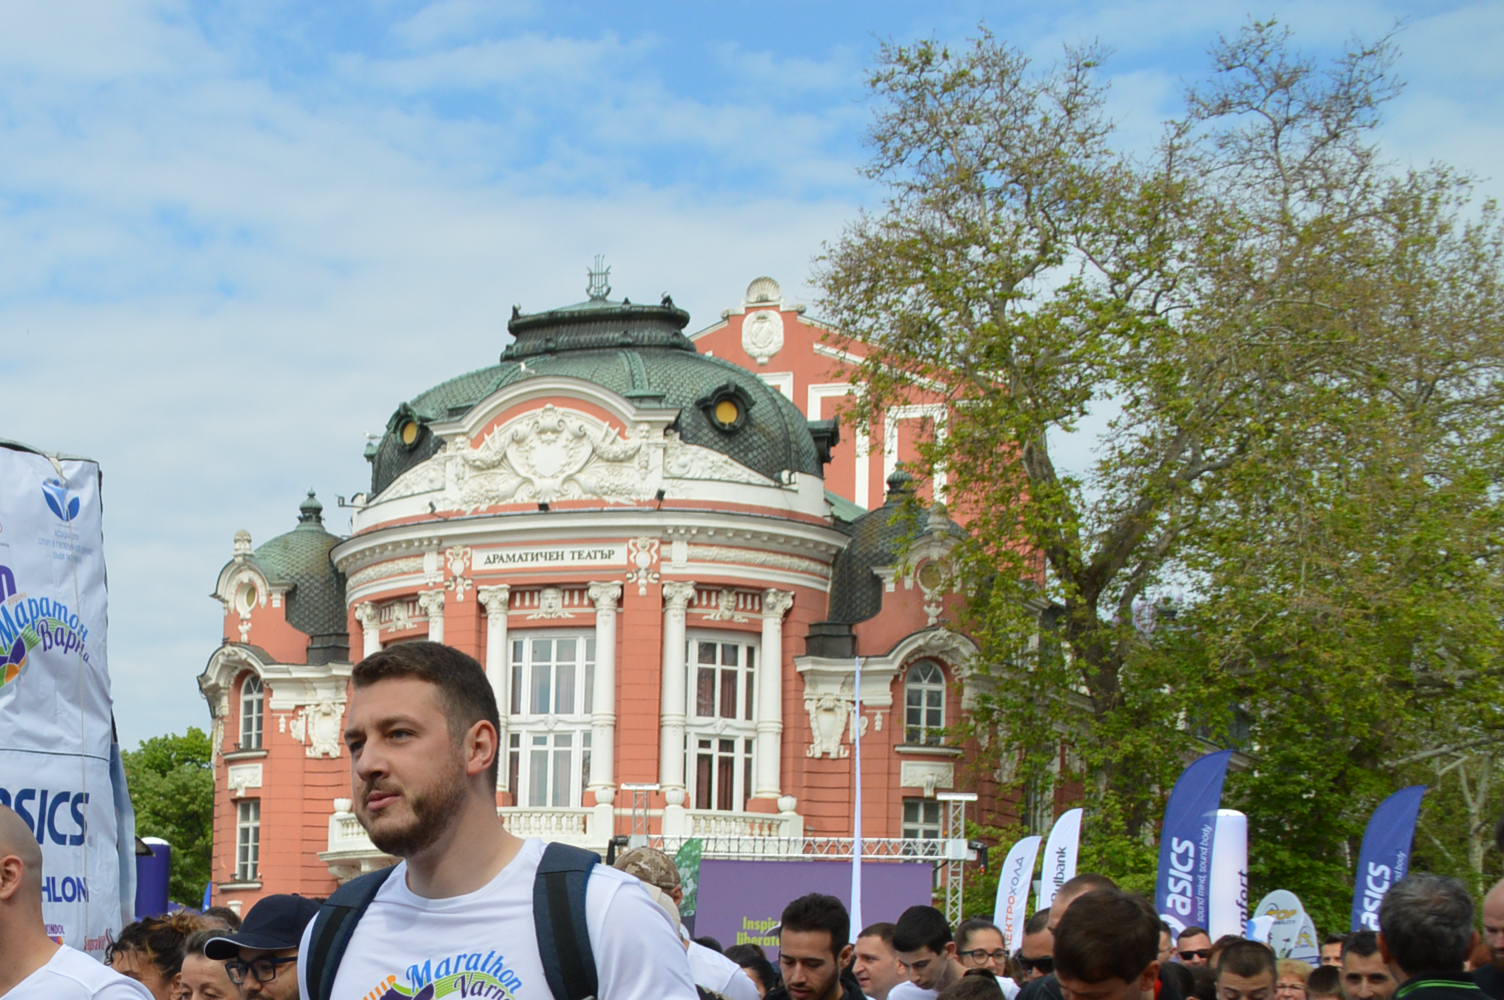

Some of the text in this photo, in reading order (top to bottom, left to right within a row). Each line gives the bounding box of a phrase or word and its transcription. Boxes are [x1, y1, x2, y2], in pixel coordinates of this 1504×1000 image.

[484, 549, 615, 565] ДРАМАТИЧЕН ТЕАТЪР
[37, 618, 90, 663] Варна
[405, 950, 523, 994] Marathon
